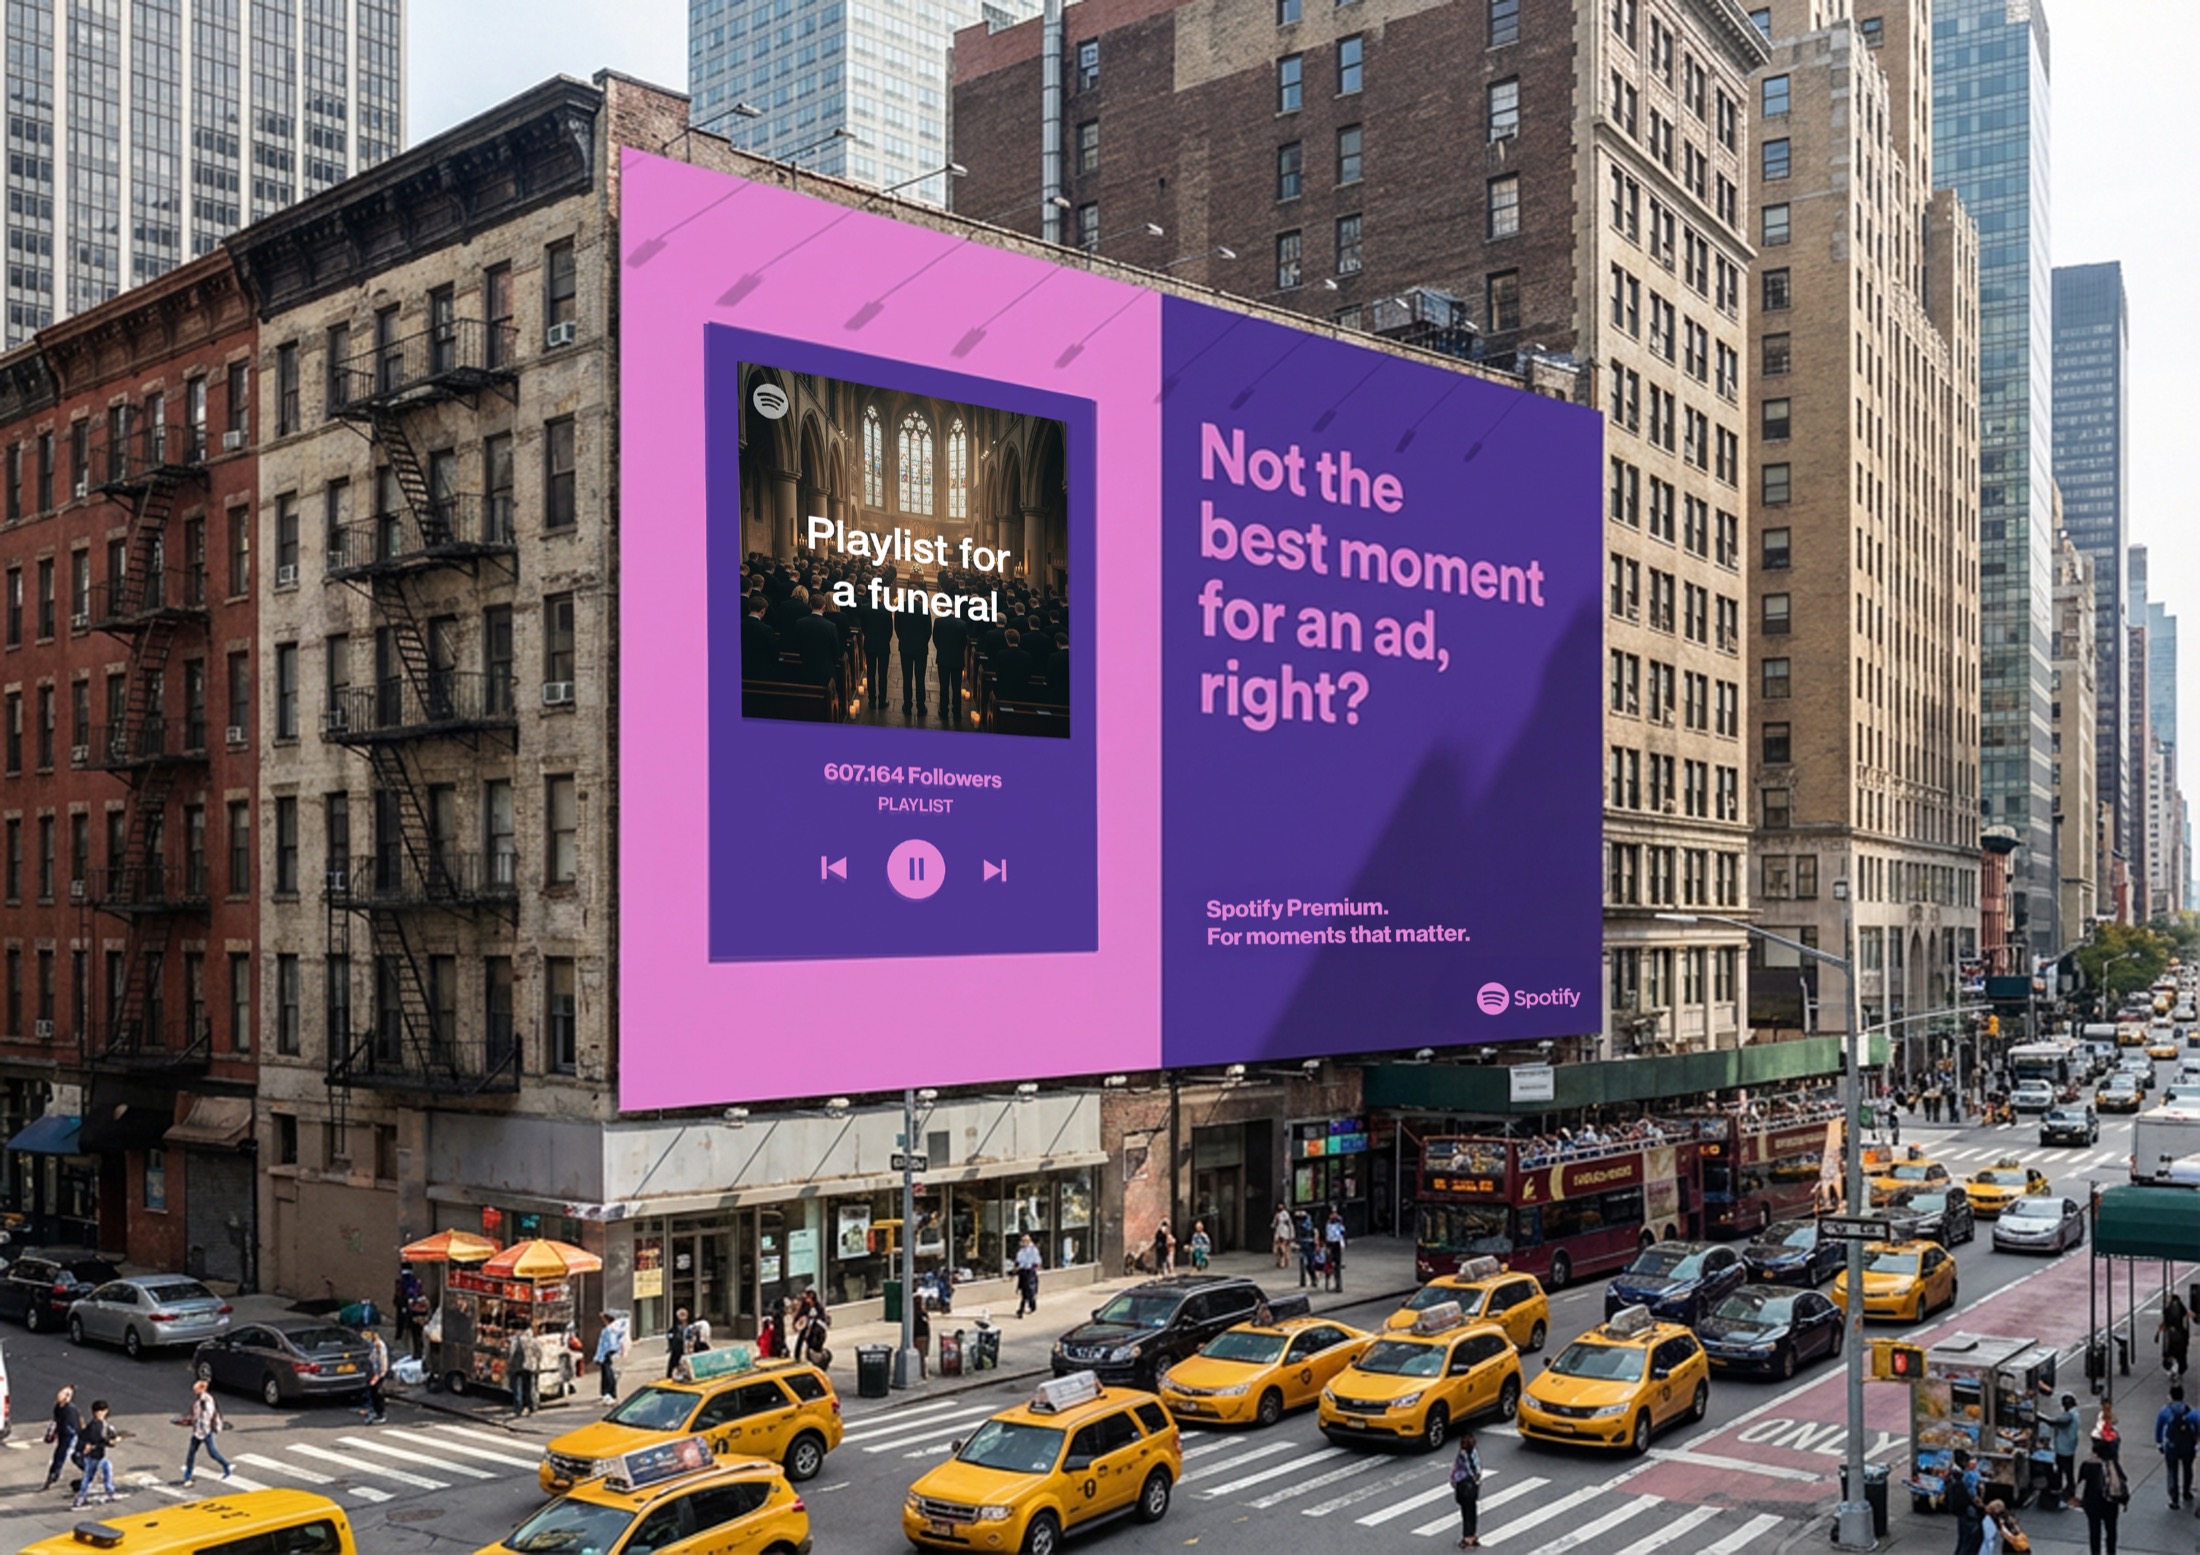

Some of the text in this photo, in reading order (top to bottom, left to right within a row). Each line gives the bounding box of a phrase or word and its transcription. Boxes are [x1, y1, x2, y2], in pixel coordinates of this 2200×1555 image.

[1201, 422, 1404, 513] Not the
[807, 515, 1011, 573] Playlist for
[1201, 500, 1545, 607] best moment
[832, 577, 998, 623] a funeral
[1198, 579, 1450, 673] for an ad,
[1201, 658, 1369, 732] right?
[823, 762, 1003, 789] 607.164 Followers
[878, 796, 954, 813] PLAYLIST
[1206, 897, 1389, 922] Spotify Premium.
[1207, 924, 1471, 946] For moments that matter.
[1514, 987, 1581, 1009] Spotify
[1737, 1418, 1910, 1461] ONLY
